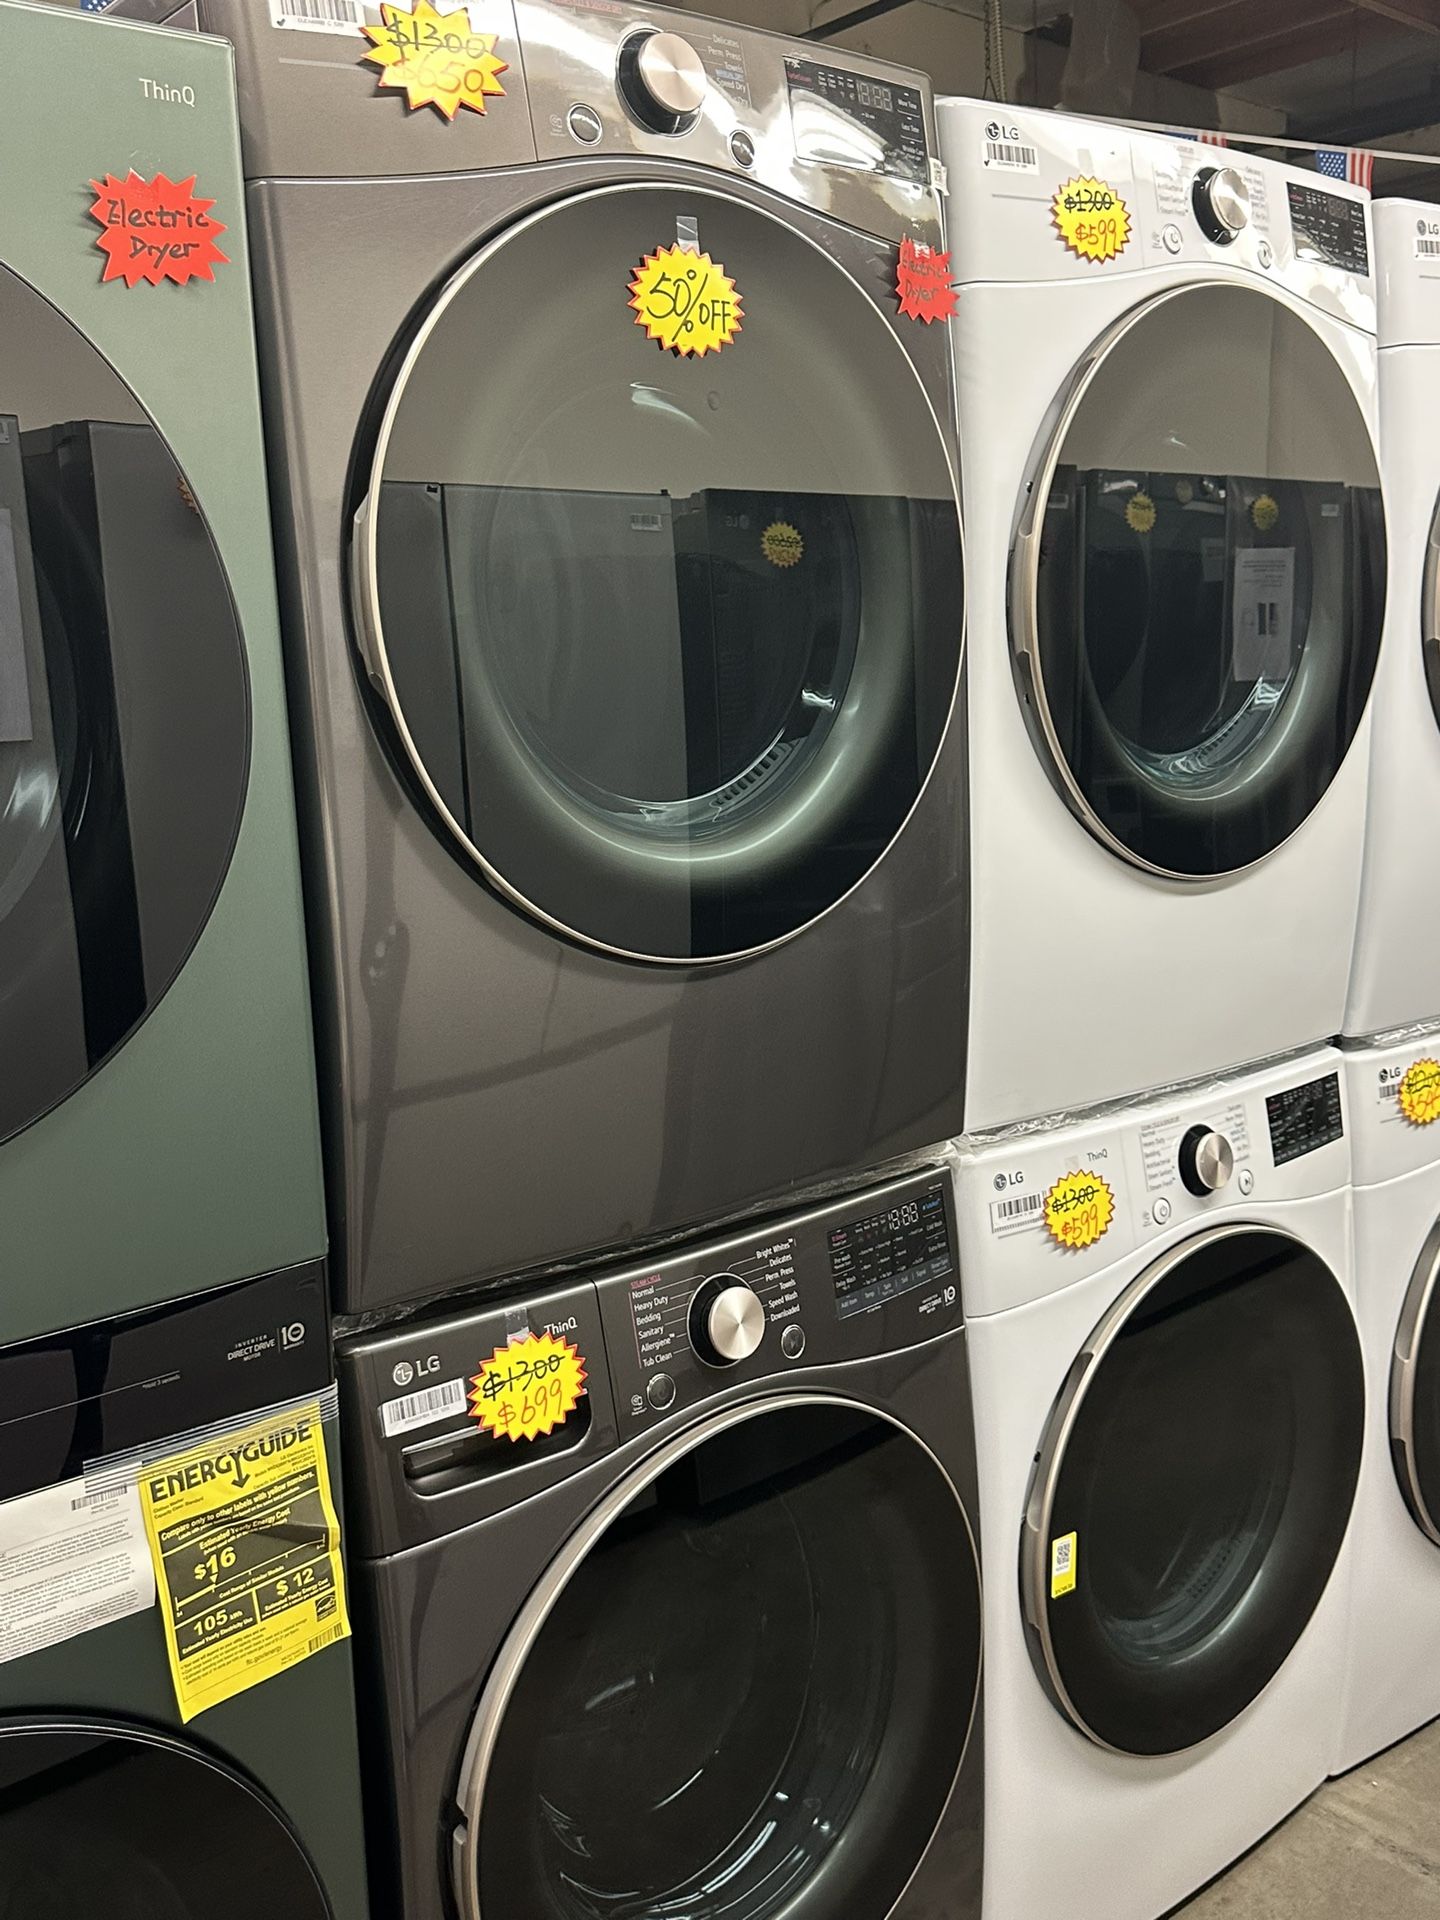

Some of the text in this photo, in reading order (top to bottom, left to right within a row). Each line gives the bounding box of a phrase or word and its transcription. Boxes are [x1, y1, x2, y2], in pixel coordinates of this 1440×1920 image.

[386, 12, 488, 60] $1300
[139, 77, 196, 108] ThinQ
[1002, 125, 1020, 141] LG
[106, 198, 210, 228] Electric
[1075, 218, 1117, 252] $599
[1428, 222, 1440, 236] LG
[129, 235, 200, 269] Dryer
[699, 300, 731, 334] OFF
[1389, 1066, 1401, 1079] LG
[1087, 1148, 1108, 1162] ThinQ
[1008, 1171, 1024, 1186] LG
[1062, 1203, 1098, 1241] $599
[756, 1247, 773, 1259] Bright
[769, 1254, 793, 1267] Delicates
[780, 1266, 795, 1277] Press
[632, 1286, 655, 1300] Normal
[779, 1278, 797, 1290] Towels
[634, 1295, 669, 1312] Heavy Duty
[768, 1290, 799, 1309] Speed Wash
[636, 1312, 661, 1326] Bedding
[770, 1303, 801, 1322] Downloaded
[543, 1316, 578, 1337] ThinQ
[638, 1325, 664, 1340] Sanitary
[227, 1322, 305, 1361] DIRECT DRIVE 10
[235, 1333, 268, 1349] INVERTER
[416, 1355, 441, 1377] LG
[642, 1352, 673, 1368] Tub Clean
[482, 1354, 566, 1402] $1300
[498, 1378, 563, 1428] $699
[149, 1418, 313, 1504] ENERGYGUIDE
[162, 1522, 188, 1542] Compare
[192, 1515, 205, 1528] only
[207, 1513, 213, 1521] to
[216, 1504, 232, 1519] other
[234, 1497, 251, 1512] labels
[254, 1491, 265, 1503] with
[267, 1481, 285, 1497] yellow
[199, 1528, 229, 1550] Estimated
[231, 1519, 250, 1536] Yearly
[253, 1512, 273, 1530] Energy
[276, 1507, 290, 1520] Cost
[194, 1546, 236, 1580] $16
[275, 1580, 289, 1596] $
[293, 1568, 315, 1587] 12
[193, 1609, 228, 1635] 105
